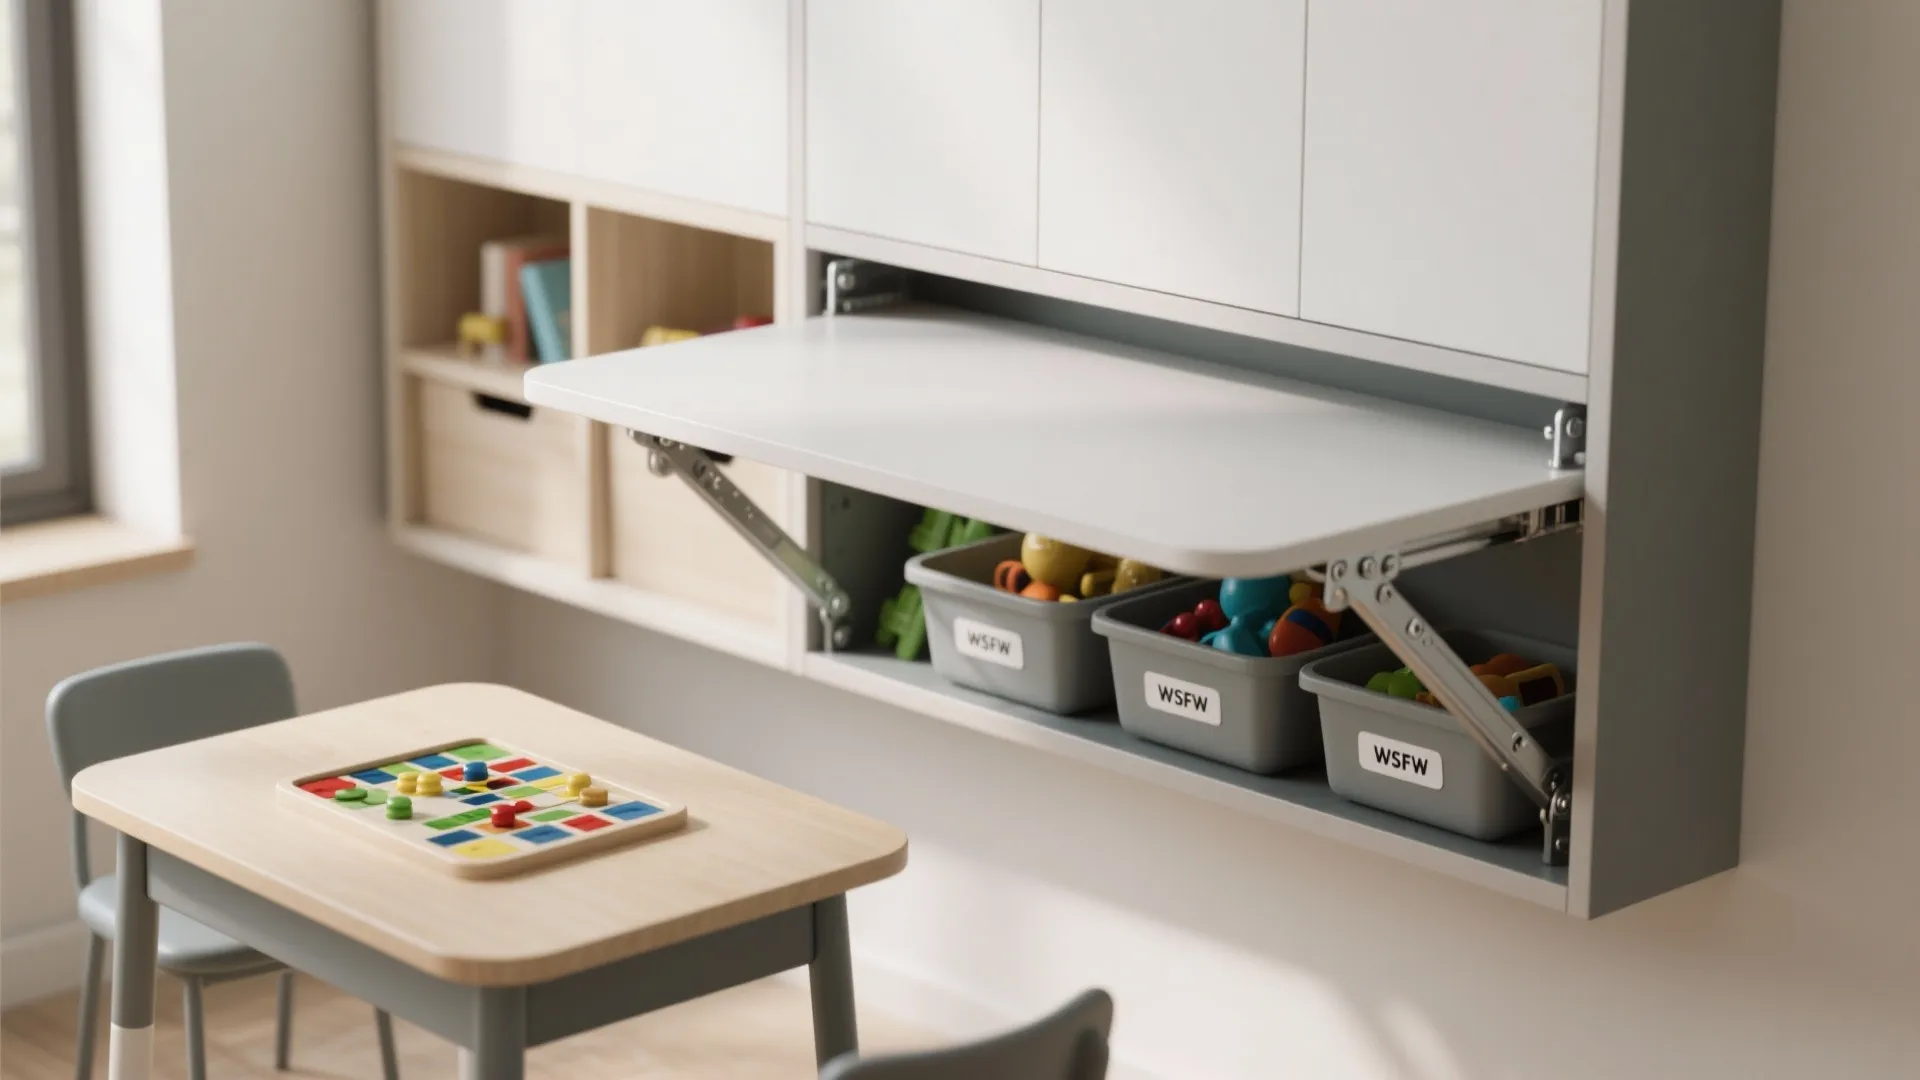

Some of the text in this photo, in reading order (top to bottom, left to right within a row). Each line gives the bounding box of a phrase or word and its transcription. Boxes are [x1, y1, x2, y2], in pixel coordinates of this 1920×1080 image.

[967, 630, 1011, 656] WSFW
[1158, 684, 1208, 712] WSFW
[1374, 744, 1428, 776] WSFW
